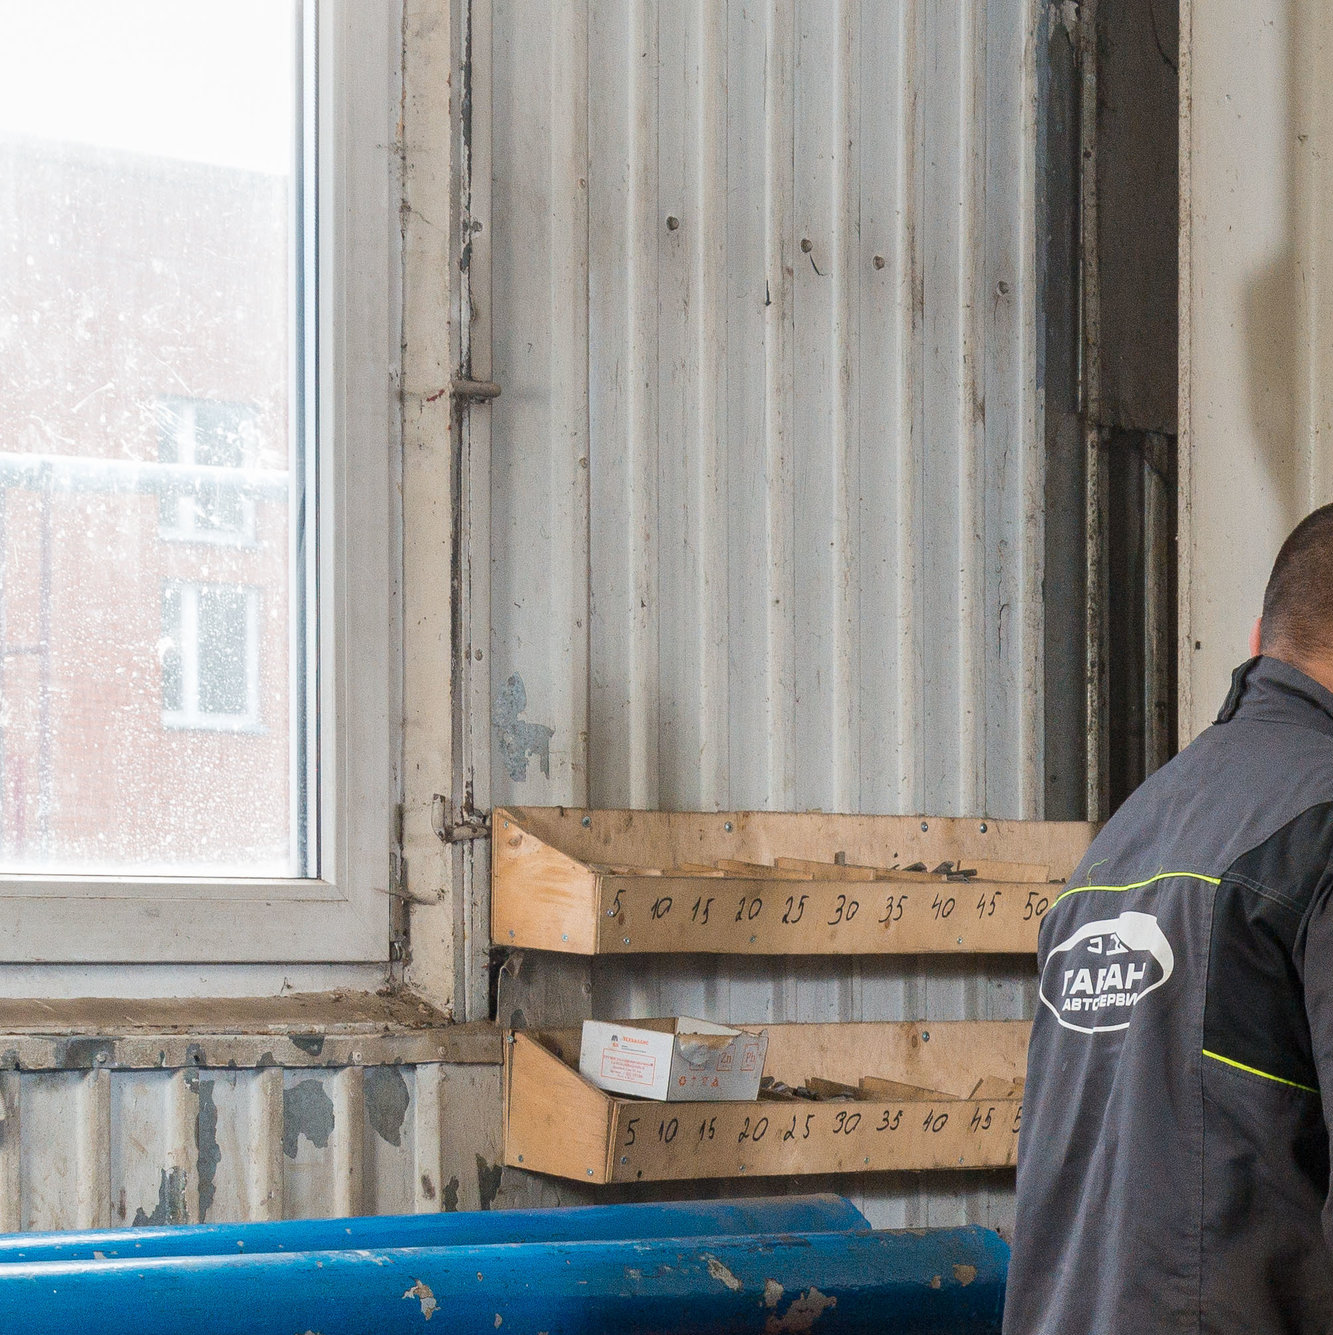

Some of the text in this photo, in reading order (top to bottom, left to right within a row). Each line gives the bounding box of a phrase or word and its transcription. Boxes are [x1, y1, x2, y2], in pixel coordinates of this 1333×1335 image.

[612, 889, 1048, 925] 5 10 15 20 25 30 35 40 45 50
[624, 1118, 640, 1146] 5
[658, 1118, 679, 1143] 10
[699, 1116, 717, 1141] 15
[738, 1117, 768, 1143] 20
[783, 1114, 815, 1141] 25
[833, 1111, 862, 1134] 30
[876, 1110, 903, 1131] 35
[922, 1109, 949, 1132] 40
[970, 1107, 995, 1133] 45
